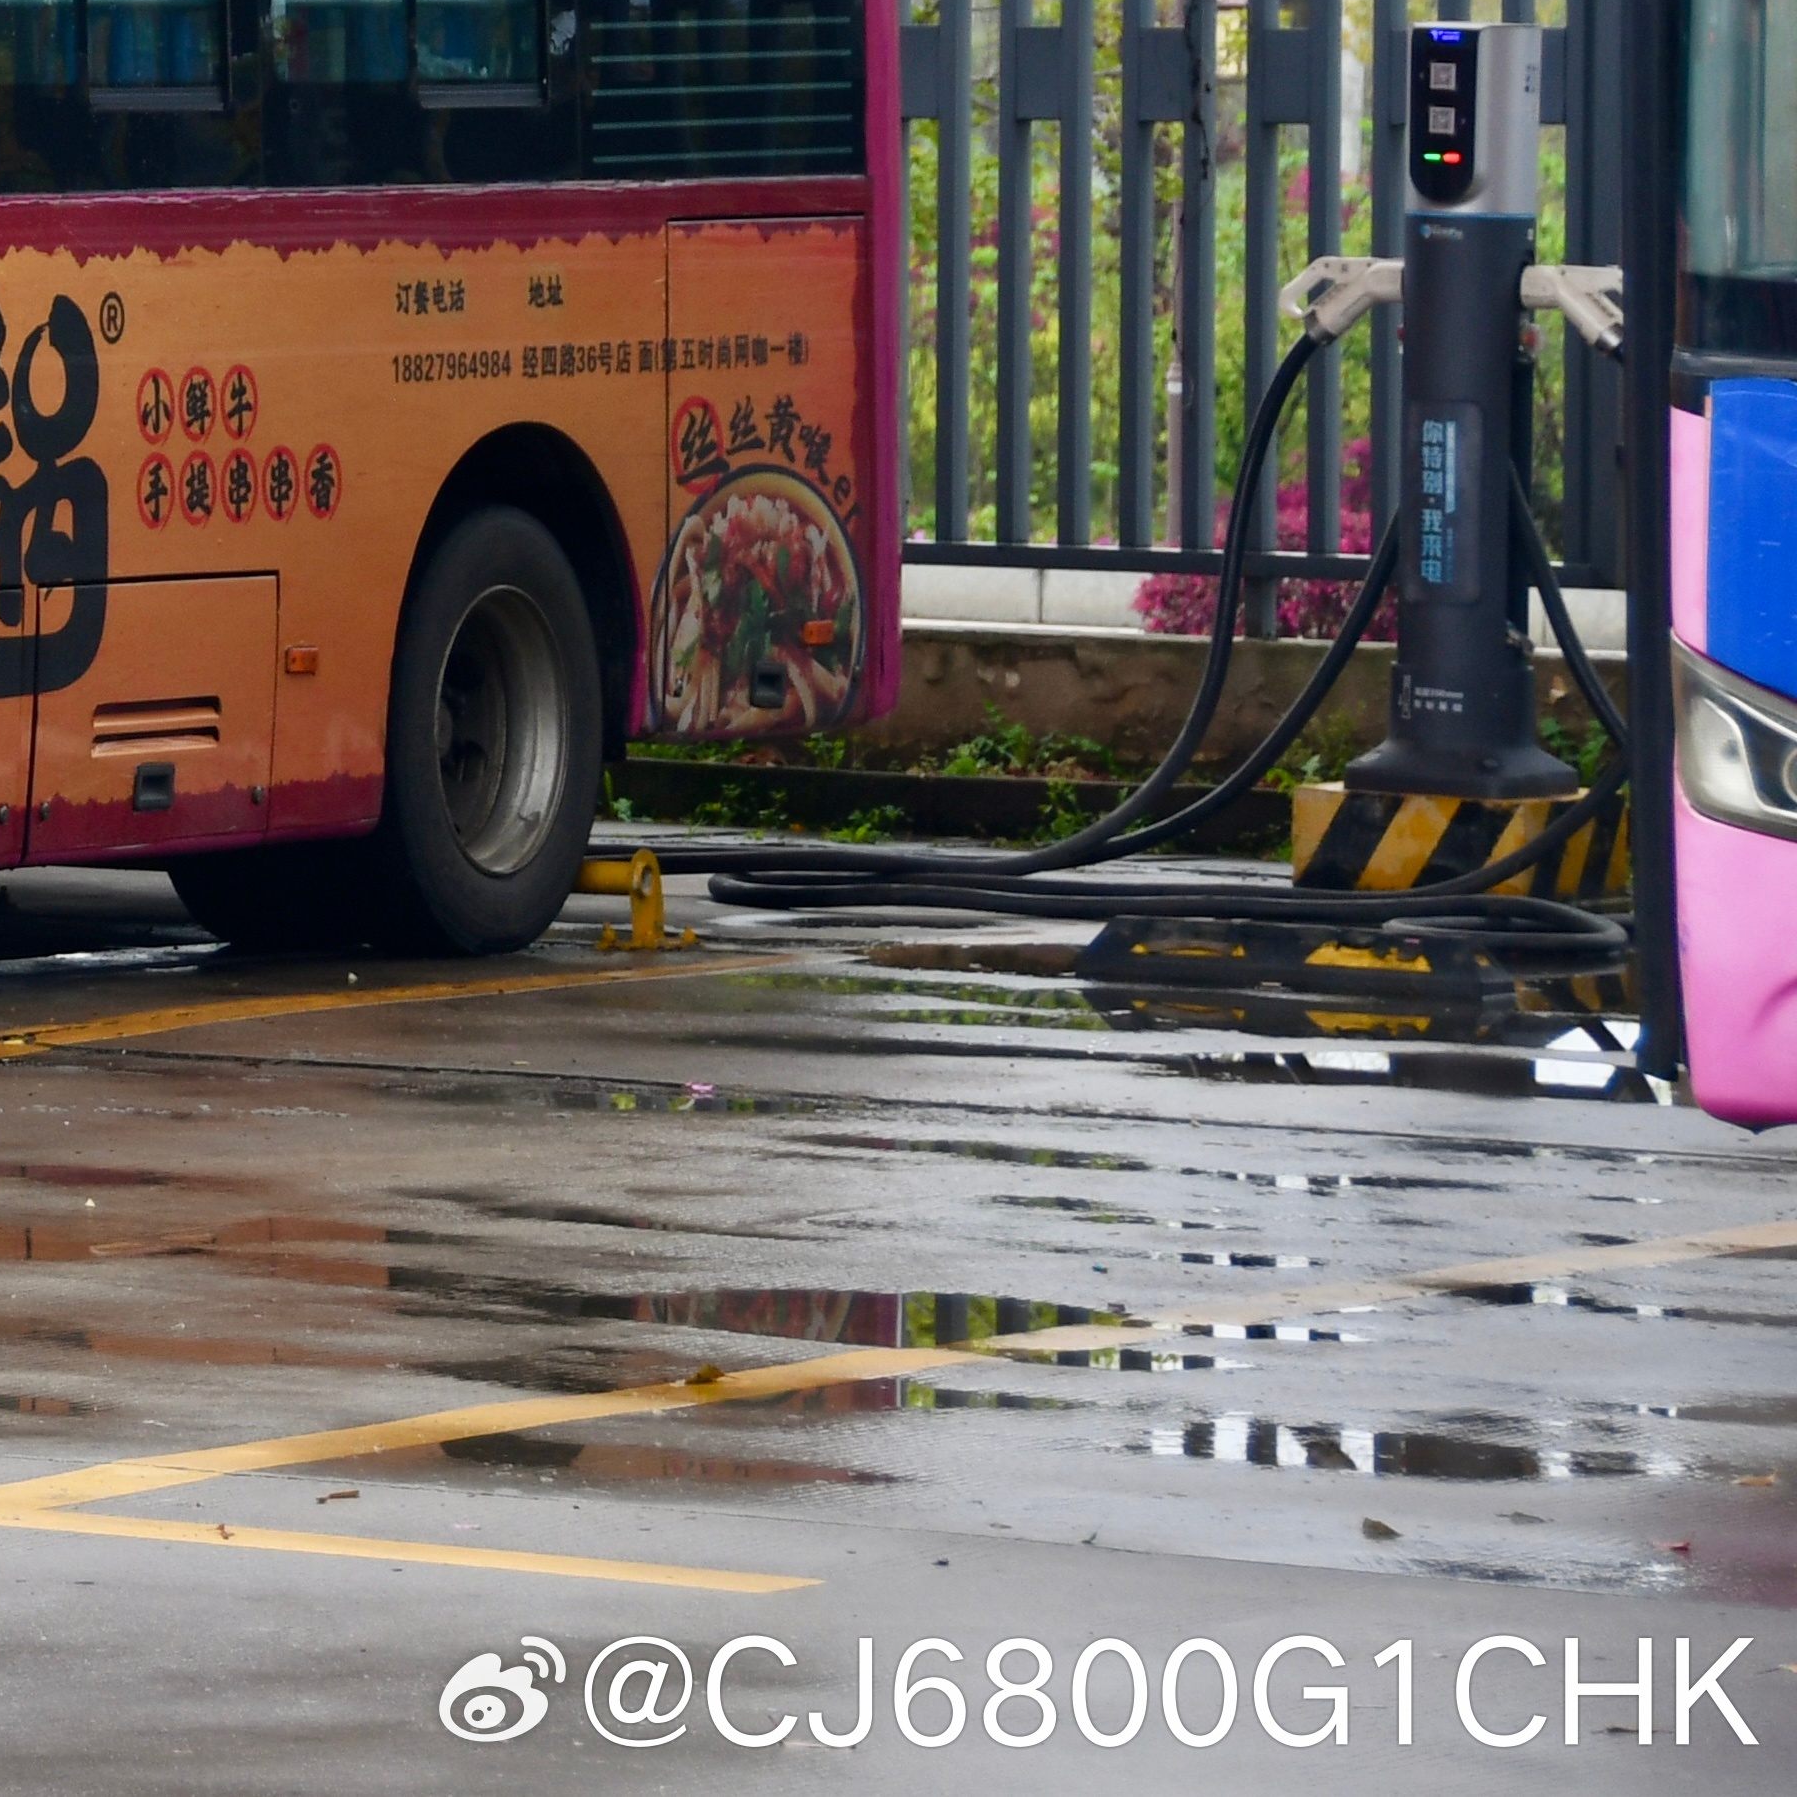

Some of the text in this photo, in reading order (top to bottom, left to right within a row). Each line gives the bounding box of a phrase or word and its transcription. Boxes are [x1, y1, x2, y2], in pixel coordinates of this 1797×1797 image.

[395, 274, 564, 317] 订餐电话 地址
[392, 349, 511, 383] 18827964984
